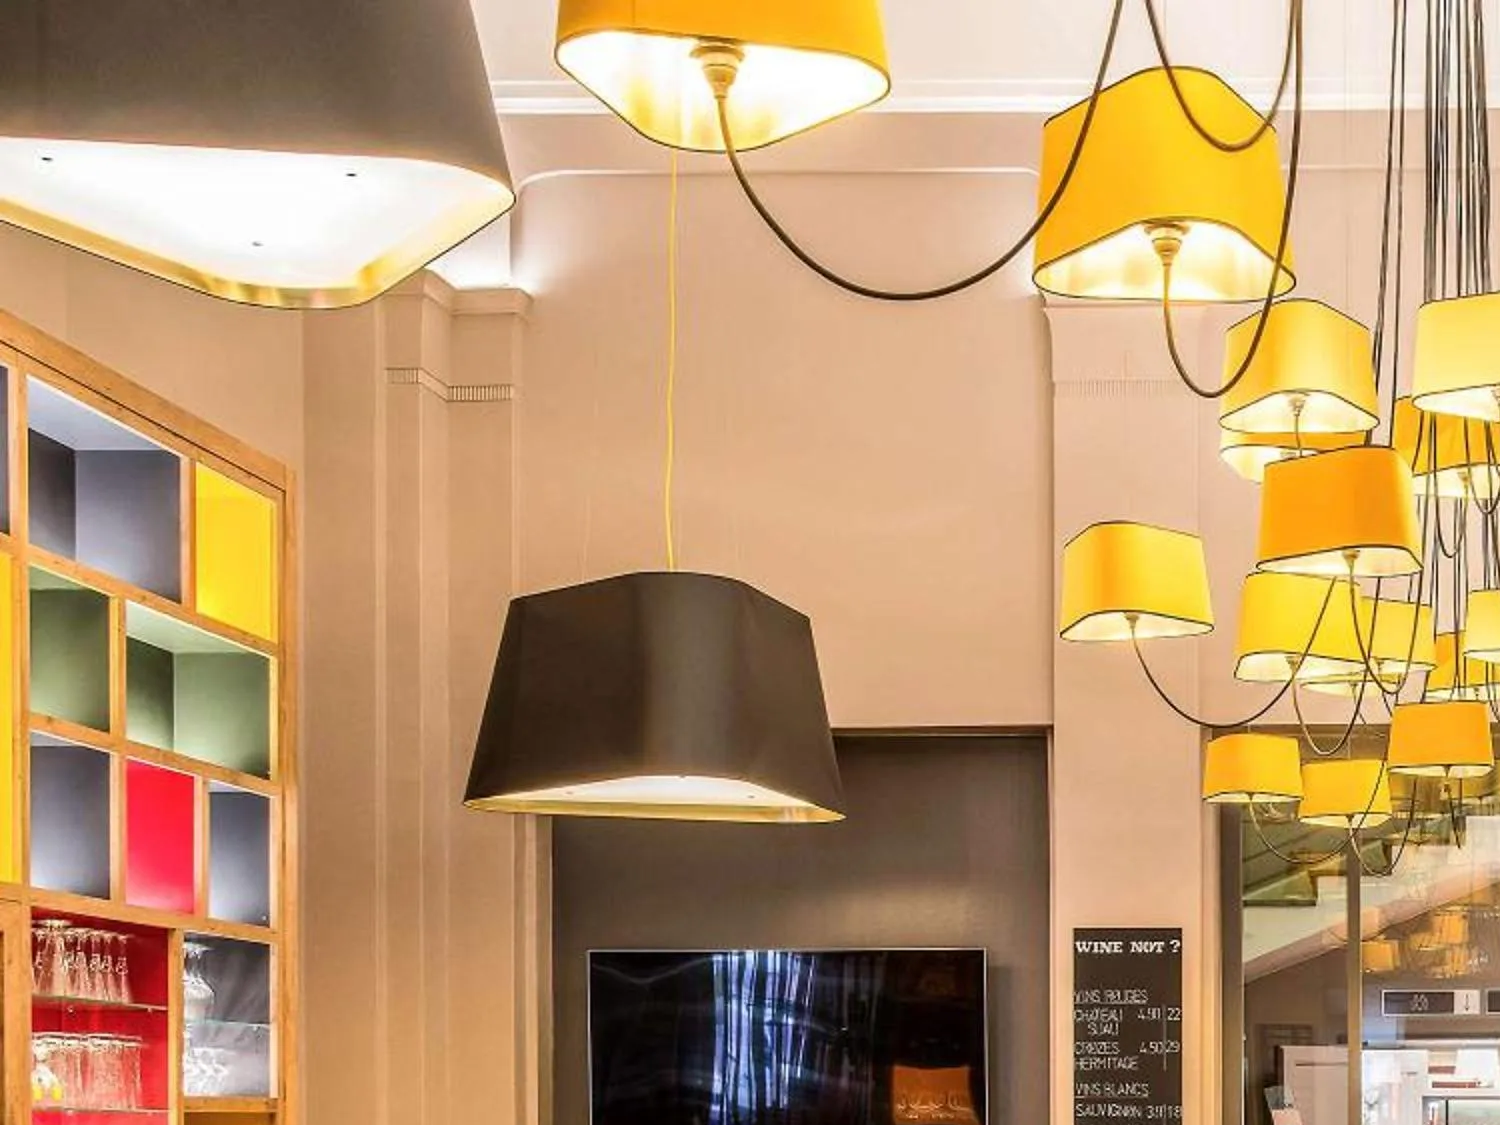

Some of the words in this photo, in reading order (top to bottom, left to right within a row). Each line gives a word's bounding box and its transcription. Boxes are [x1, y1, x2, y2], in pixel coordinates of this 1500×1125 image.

[1075, 941, 1123, 953] WINE
[1129, 941, 1164, 953] NOT
[1170, 939, 1181, 953] ?
[1074, 989, 1100, 1003] VINS
[1104, 989, 1149, 1003] ROUGES
[1167, 1007, 1181, 1021] 22
[1075, 1056, 1140, 1071] HERMITAGE
[1075, 1082, 1101, 1097] VINS
[1103, 1082, 1149, 1097] BLANCS
[1075, 1103, 1141, 1118] SAUVIGNON
